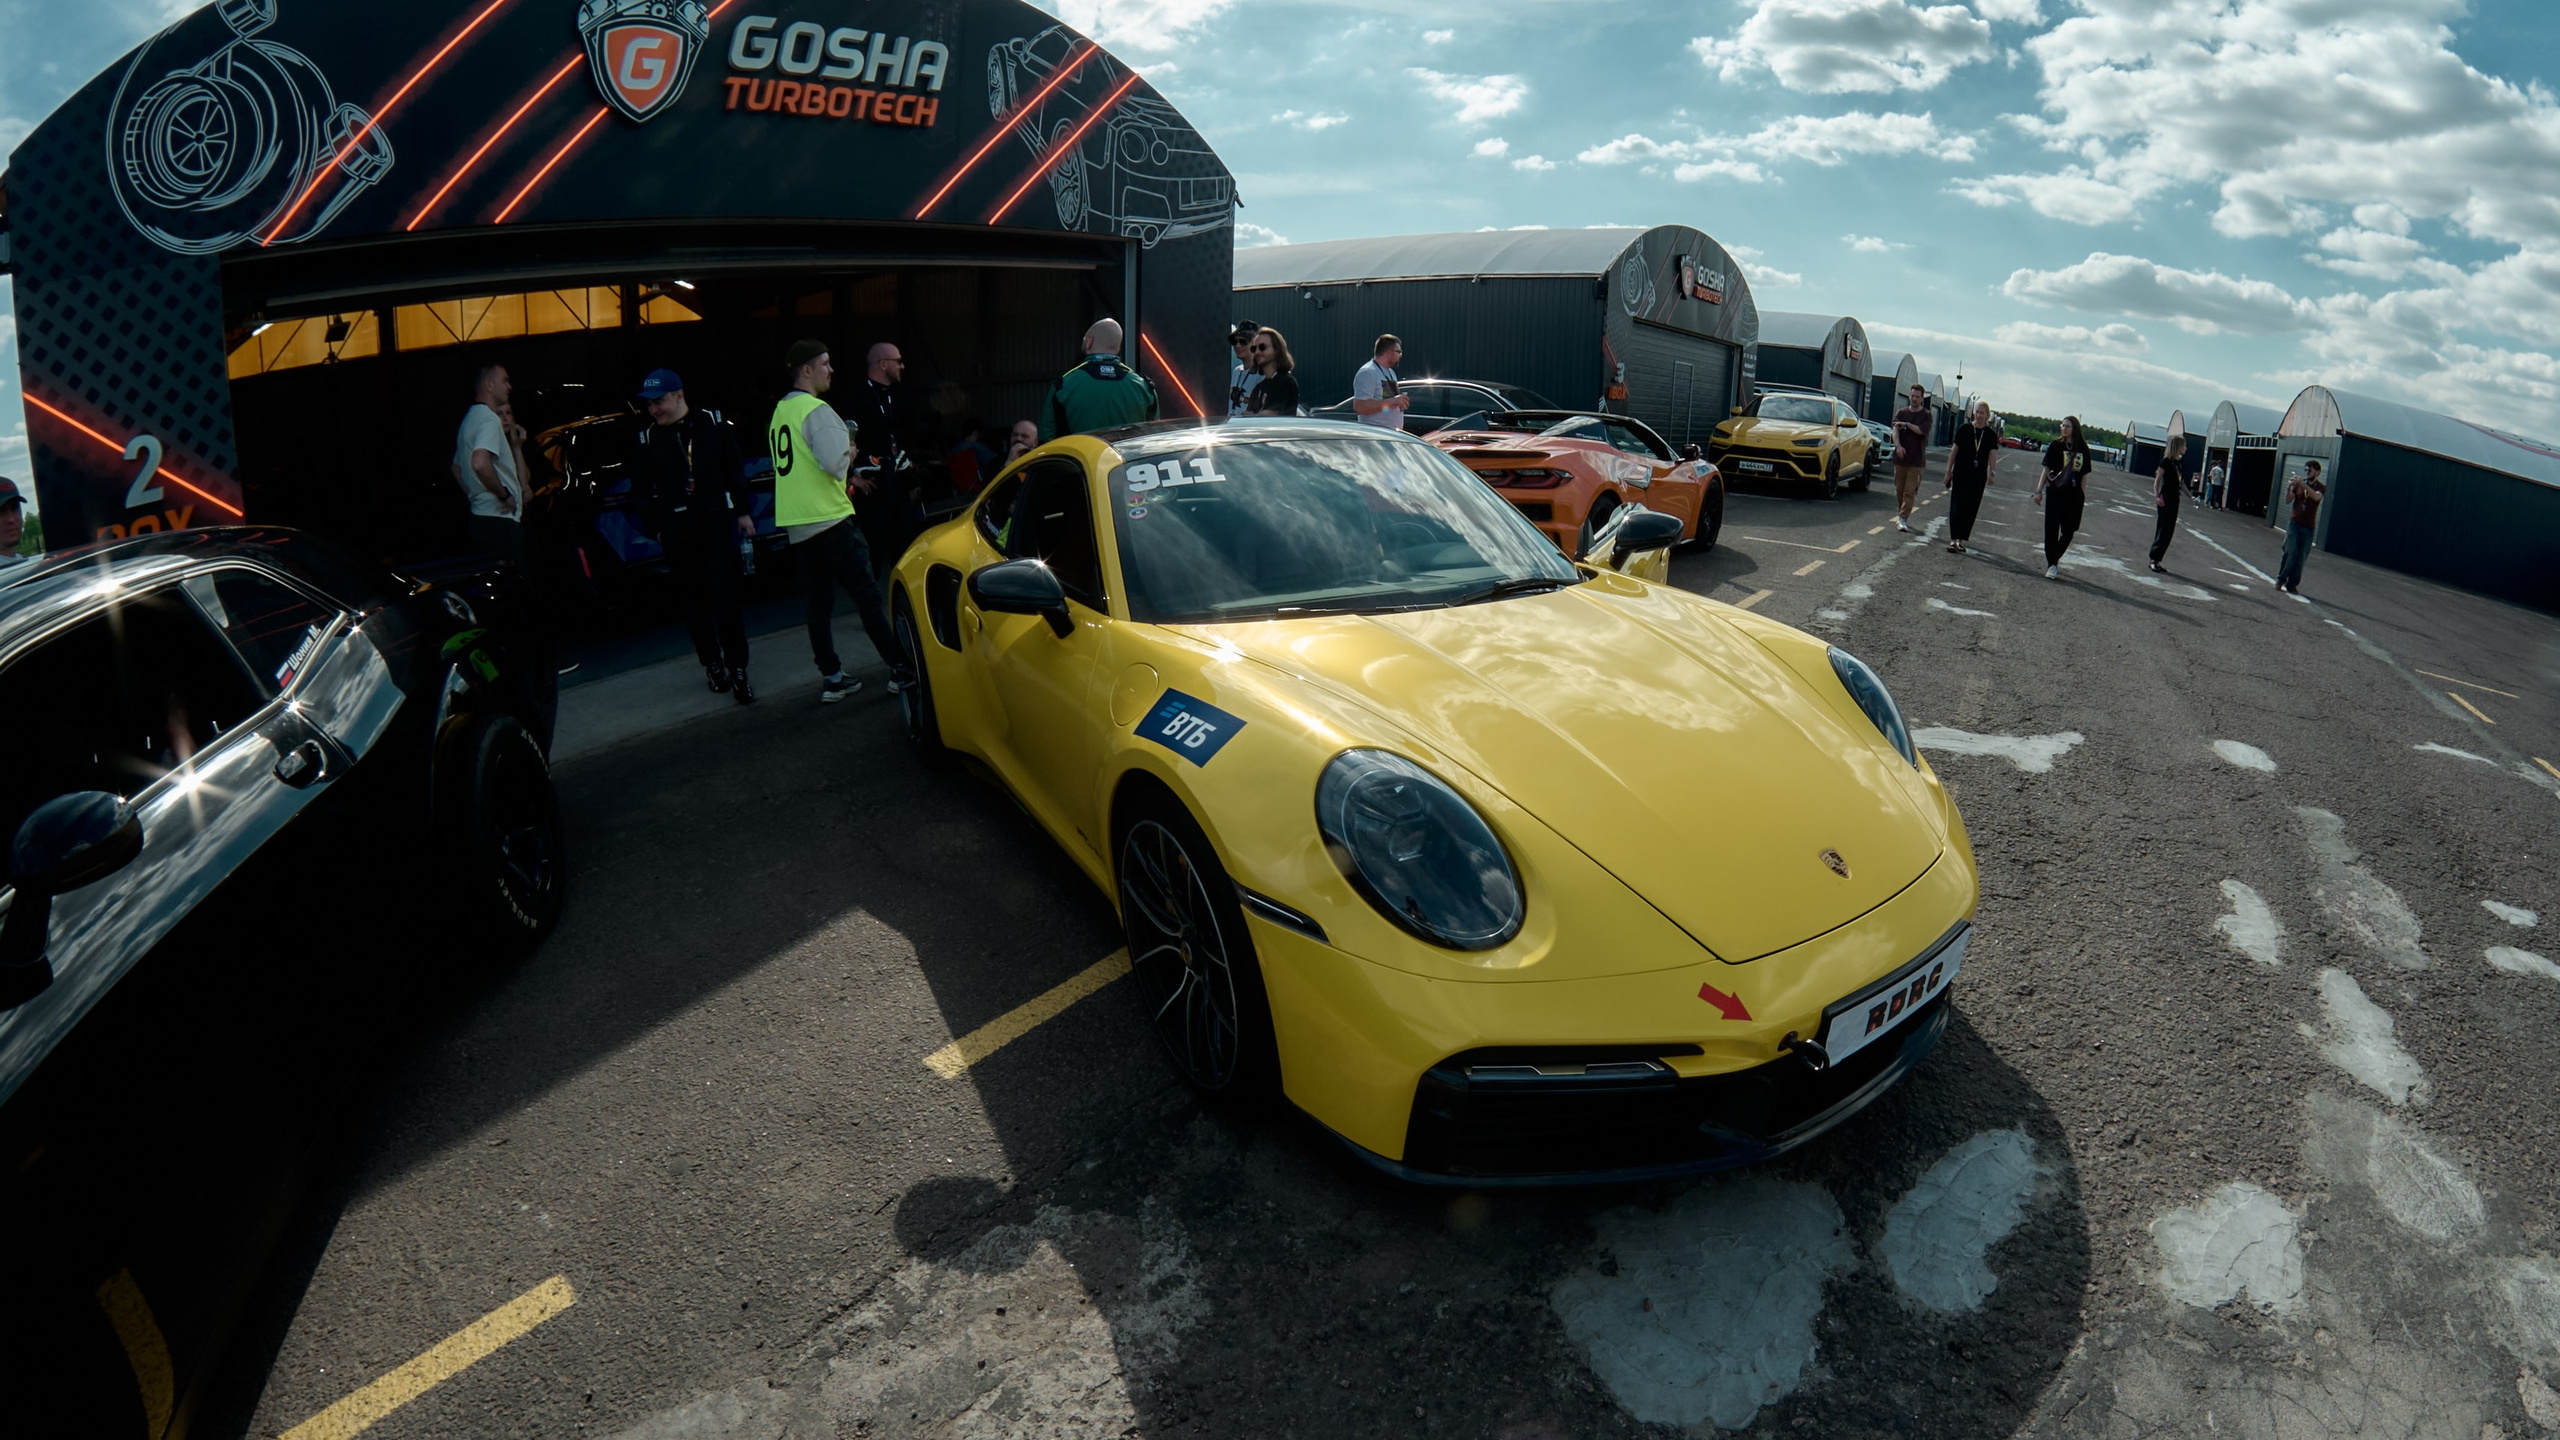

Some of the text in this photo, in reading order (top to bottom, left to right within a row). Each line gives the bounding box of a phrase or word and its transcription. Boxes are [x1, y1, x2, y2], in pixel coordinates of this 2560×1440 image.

[619, 36, 667, 91] G
[728, 14, 949, 92] GOSHA
[722, 76, 939, 128] TURBOTECH
[1697, 265, 1725, 292] GOSHA
[123, 434, 165, 509] 2
[1126, 457, 1226, 492] 911
[287, 635, 314, 671] Шония
[1161, 711, 1217, 748] ВТБ
